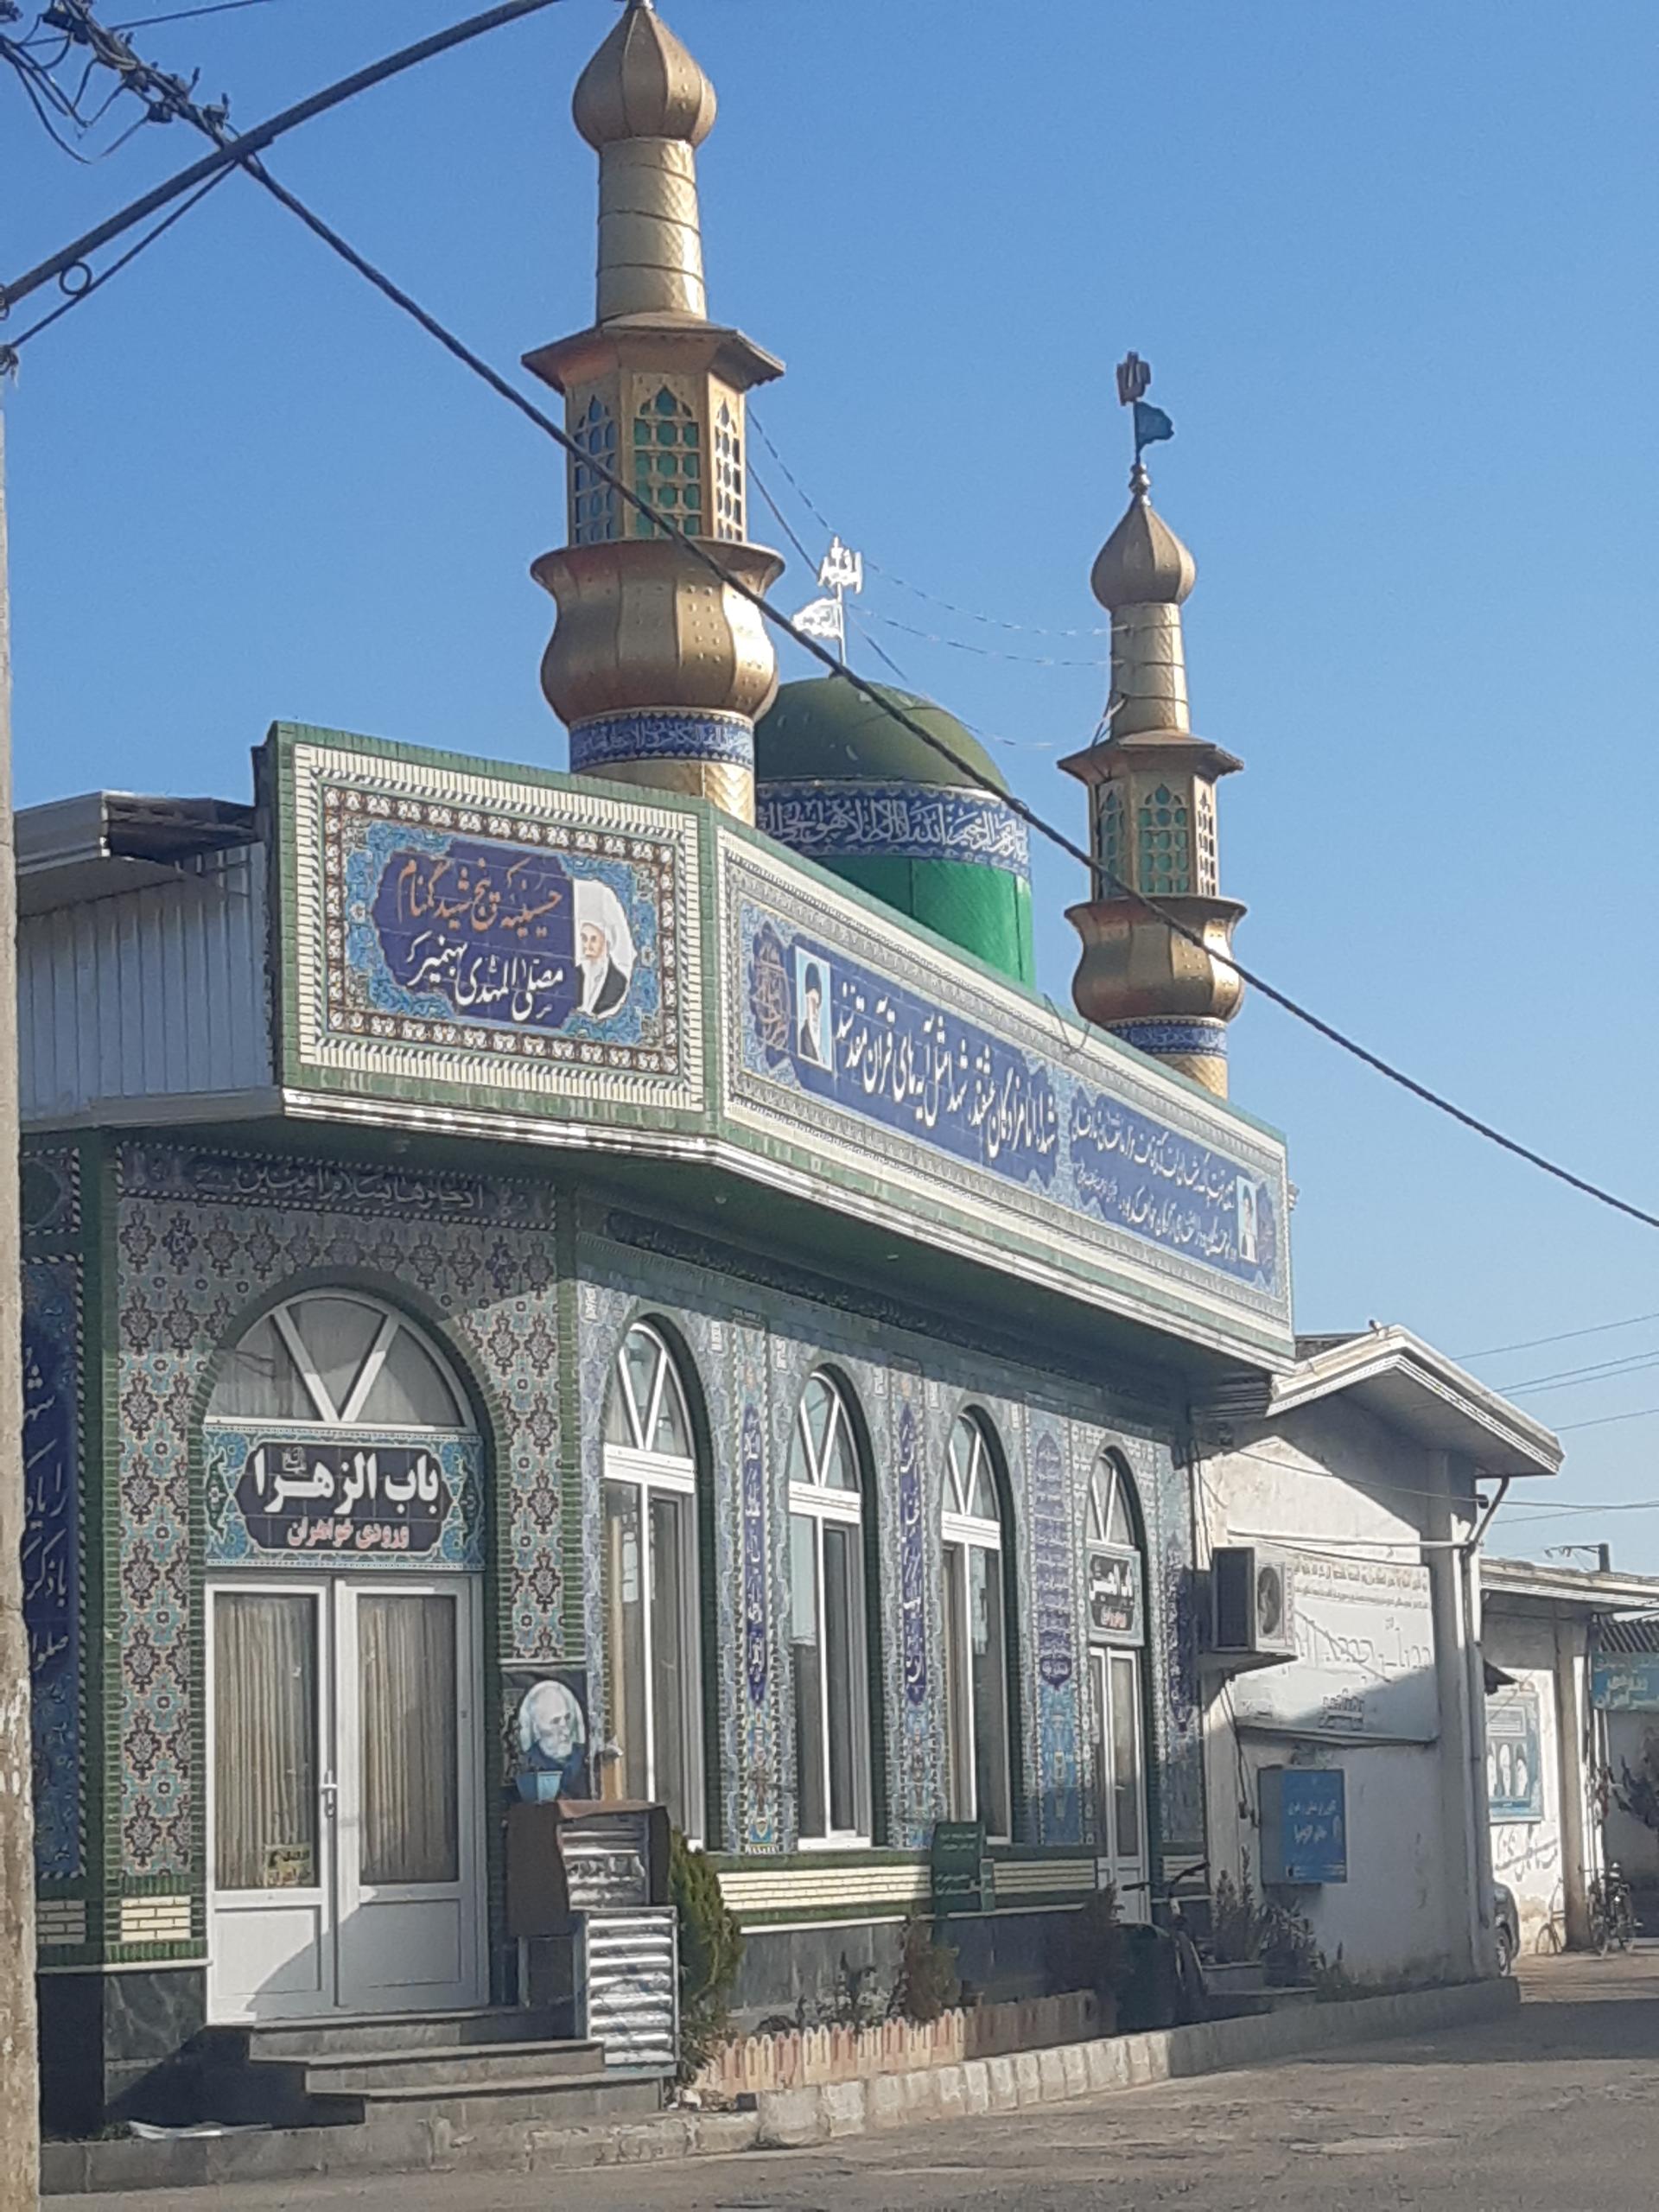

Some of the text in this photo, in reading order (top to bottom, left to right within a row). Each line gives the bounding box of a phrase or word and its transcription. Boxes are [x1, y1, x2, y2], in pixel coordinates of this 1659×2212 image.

[253, 1447, 378, 1514] الزهرا
[385, 1452, 440, 1515] باب
[287, 1516, 410, 1550] ورودی خواهران
[33, 1631, 69, 1671] صلوا
